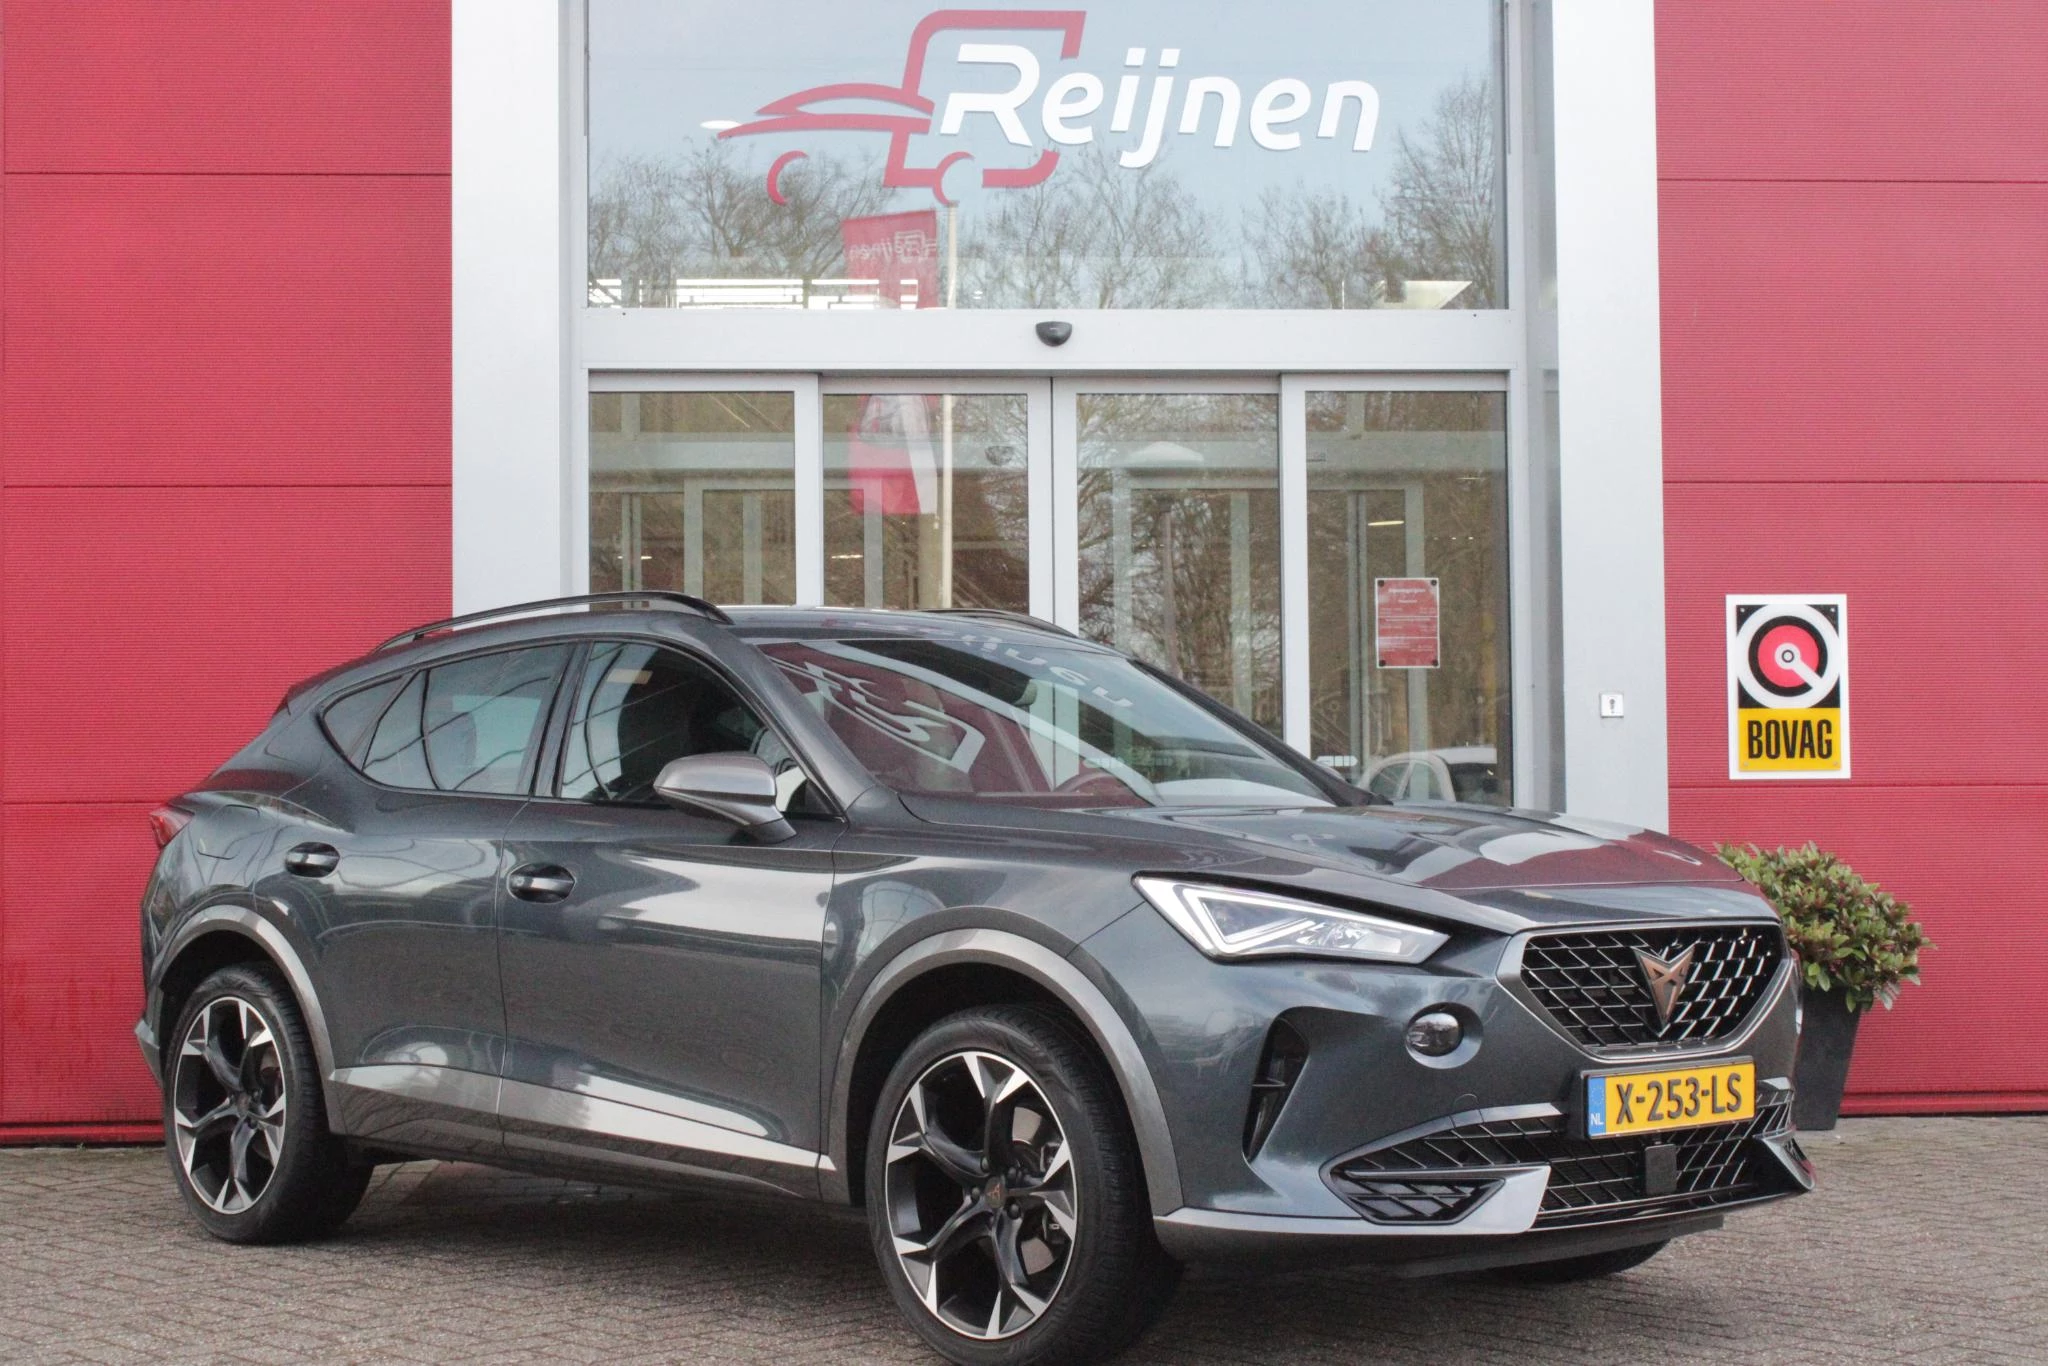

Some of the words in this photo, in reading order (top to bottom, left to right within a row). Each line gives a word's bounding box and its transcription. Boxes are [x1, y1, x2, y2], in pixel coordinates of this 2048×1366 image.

[939, 43, 1381, 168] Reijnen
[1747, 718, 1833, 760] BOVAG
[1590, 1112, 1604, 1126] NL
[1615, 1072, 1743, 1125] X-253-LS
